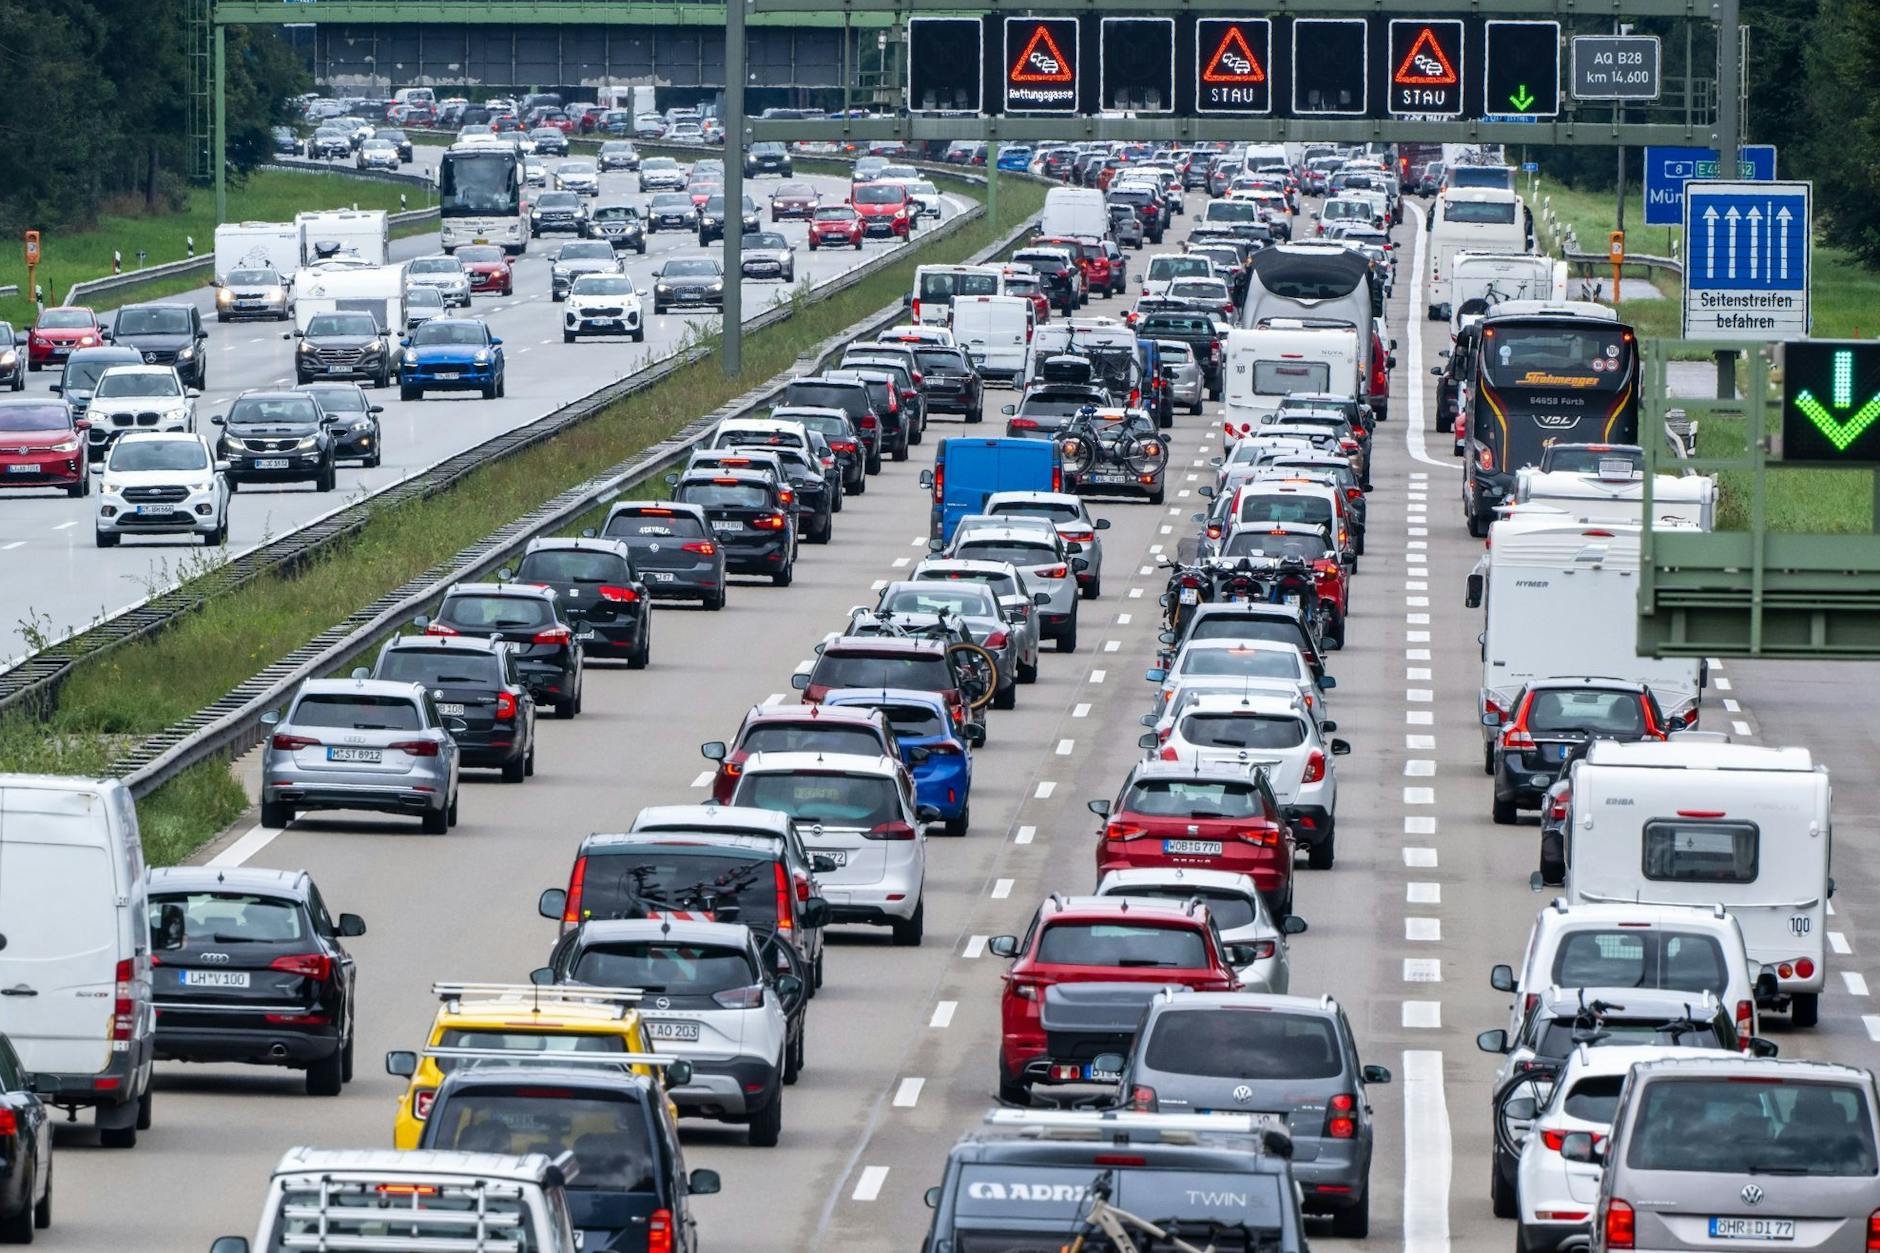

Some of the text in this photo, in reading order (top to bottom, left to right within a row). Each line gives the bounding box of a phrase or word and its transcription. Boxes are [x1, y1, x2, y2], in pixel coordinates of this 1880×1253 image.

[1594, 52, 1642, 64] AQ B28
[1587, 71, 1649, 83] km 14.600
[1009, 88, 1074, 102] Rettungsgasse
[1211, 88, 1253, 102] STAU
[1403, 90, 1446, 104] STAU
[1675, 164, 1683, 174] 8
[1701, 292, 1792, 308] Seitenstreifen
[1717, 313, 1774, 328] befahren
[1541, 415, 1571, 425] VDL
[1516, 580, 1549, 588] HYMER
[448, 704, 463, 714] 108
[346, 750, 358, 759] ST
[359, 750, 381, 760] 8912
[1169, 841, 1188, 851] WOB
[1202, 842, 1221, 852] 770
[1791, 917, 1810, 933] 100
[191, 974, 206, 984] LH
[224, 975, 244, 985] 100
[657, 1024, 697, 1037] AO 203
[1185, 1190, 1246, 1206] TWIN
[1718, 1220, 1791, 1235] ÖHR DI 77
